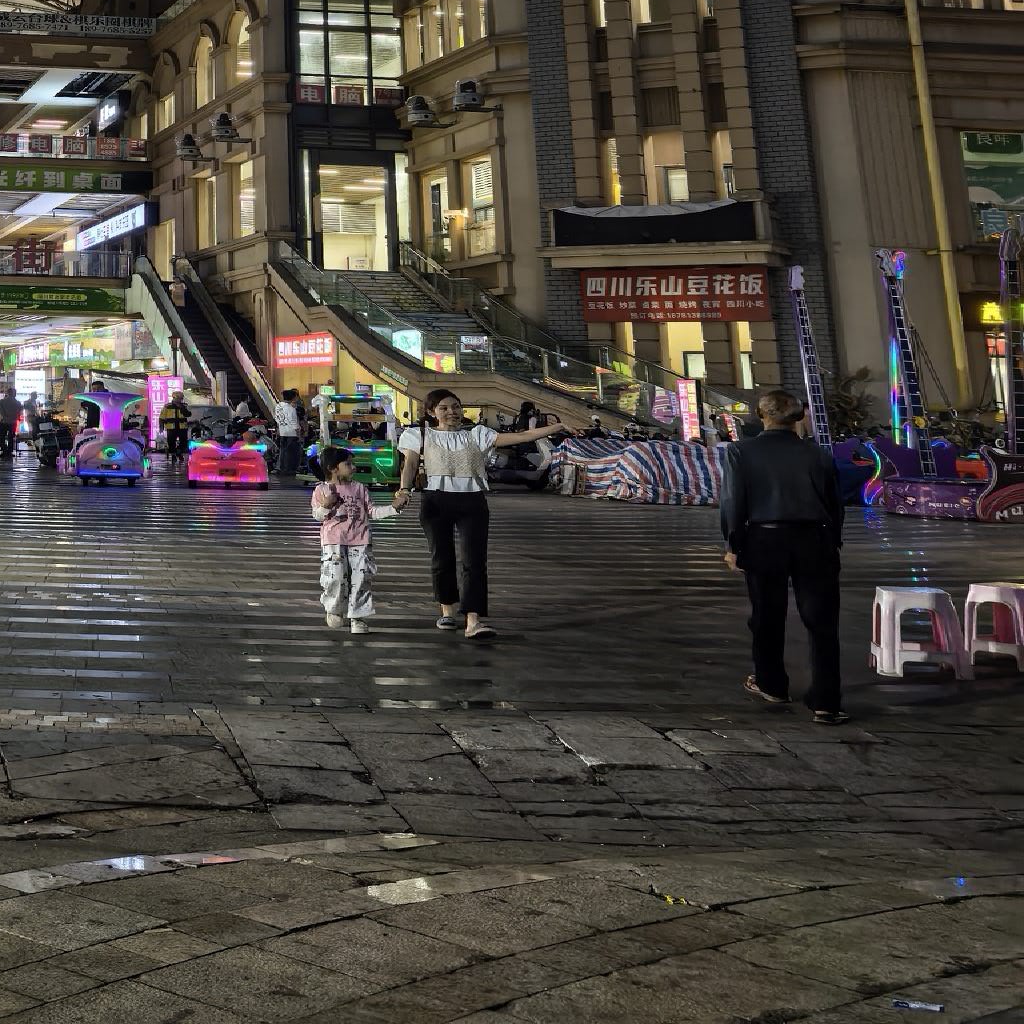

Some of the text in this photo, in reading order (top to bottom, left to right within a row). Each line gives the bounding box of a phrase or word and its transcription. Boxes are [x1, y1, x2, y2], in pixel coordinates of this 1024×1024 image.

[587, 275, 763, 296] 四川乐山豆花饭
